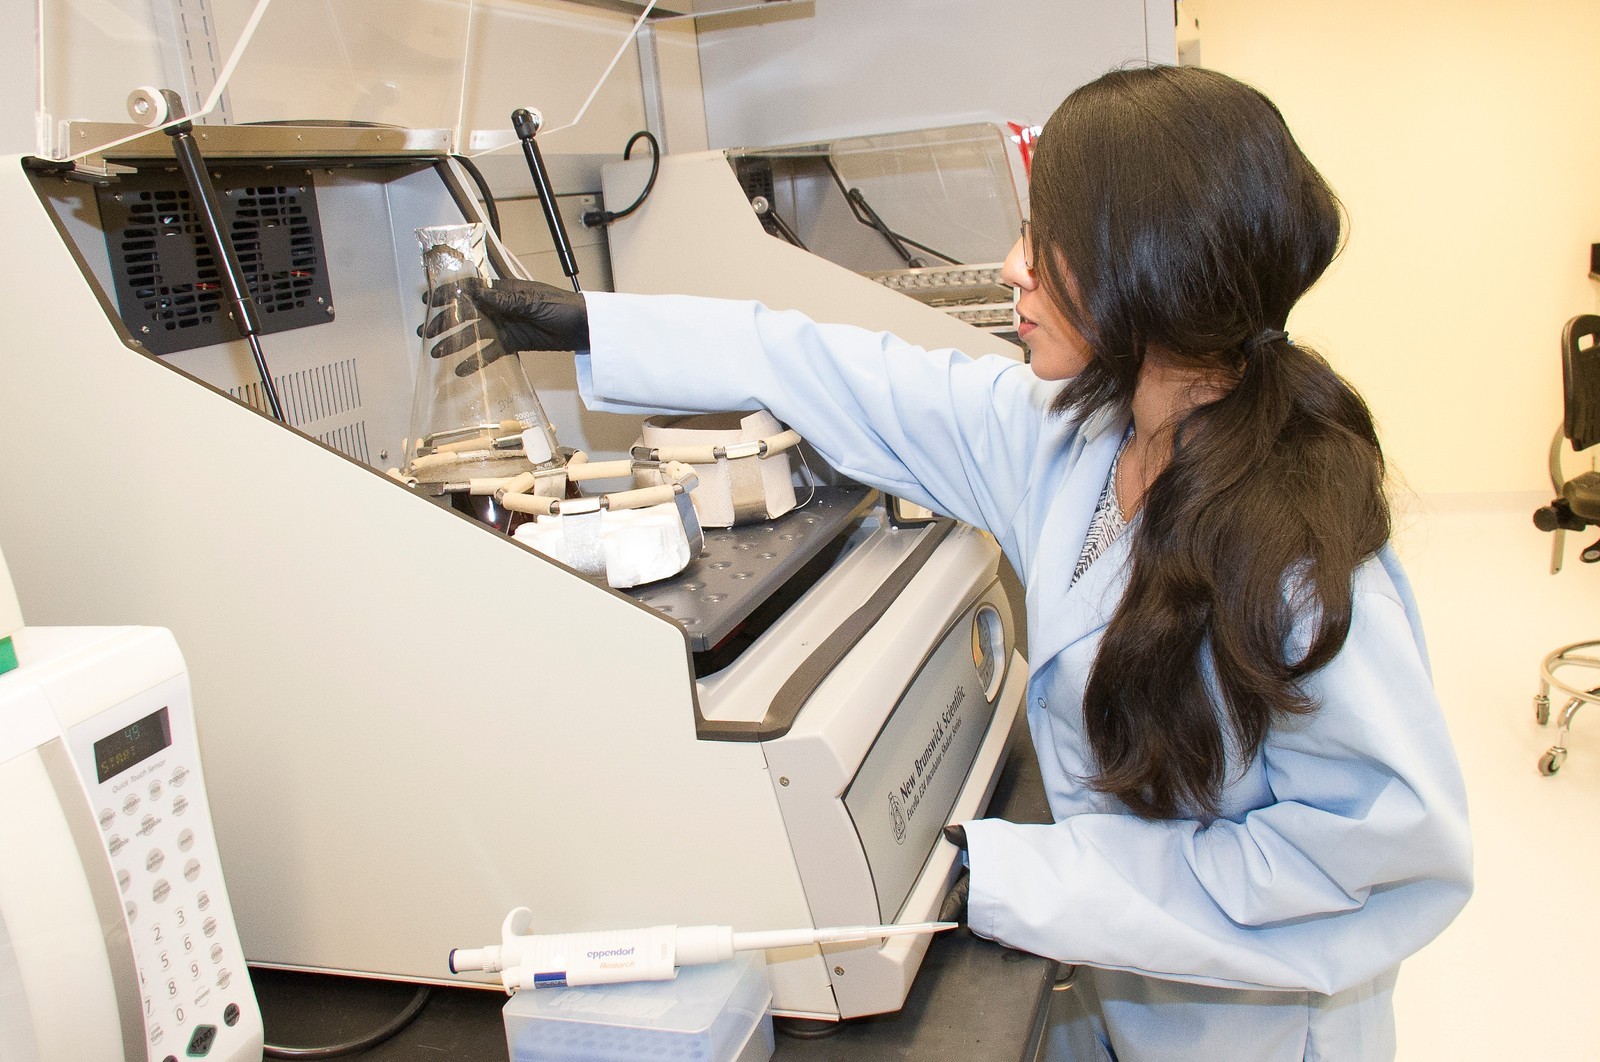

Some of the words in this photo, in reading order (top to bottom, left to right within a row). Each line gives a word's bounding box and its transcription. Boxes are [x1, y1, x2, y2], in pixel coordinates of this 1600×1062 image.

[899, 772, 916, 804] New
[914, 721, 944, 778] Brunswick
[942, 685, 966, 729] Scientific
[112, 780, 129, 794] Quick
[130, 769, 147, 782] Touch
[147, 759, 166, 774] Sensor
[168, 769, 190, 786] popcorn
[122, 797, 141, 813] potato
[180, 834, 193, 847] melt
[146, 854, 166, 871] defrost
[184, 863, 201, 878] soften
[176, 910, 185, 925] 3
[153, 926, 162, 941] 2
[184, 936, 192, 951] 6
[587, 946, 635, 959] eppendorf
[160, 953, 169, 968] 5
[600, 961, 635, 969] Research
[191, 963, 199, 978] 9
[168, 981, 177, 995] 8
[194, 988, 211, 1005] power
[145, 999, 151, 1014] 7
[176, 1008, 184, 1021] 0
[191, 1027, 213, 1052] START
